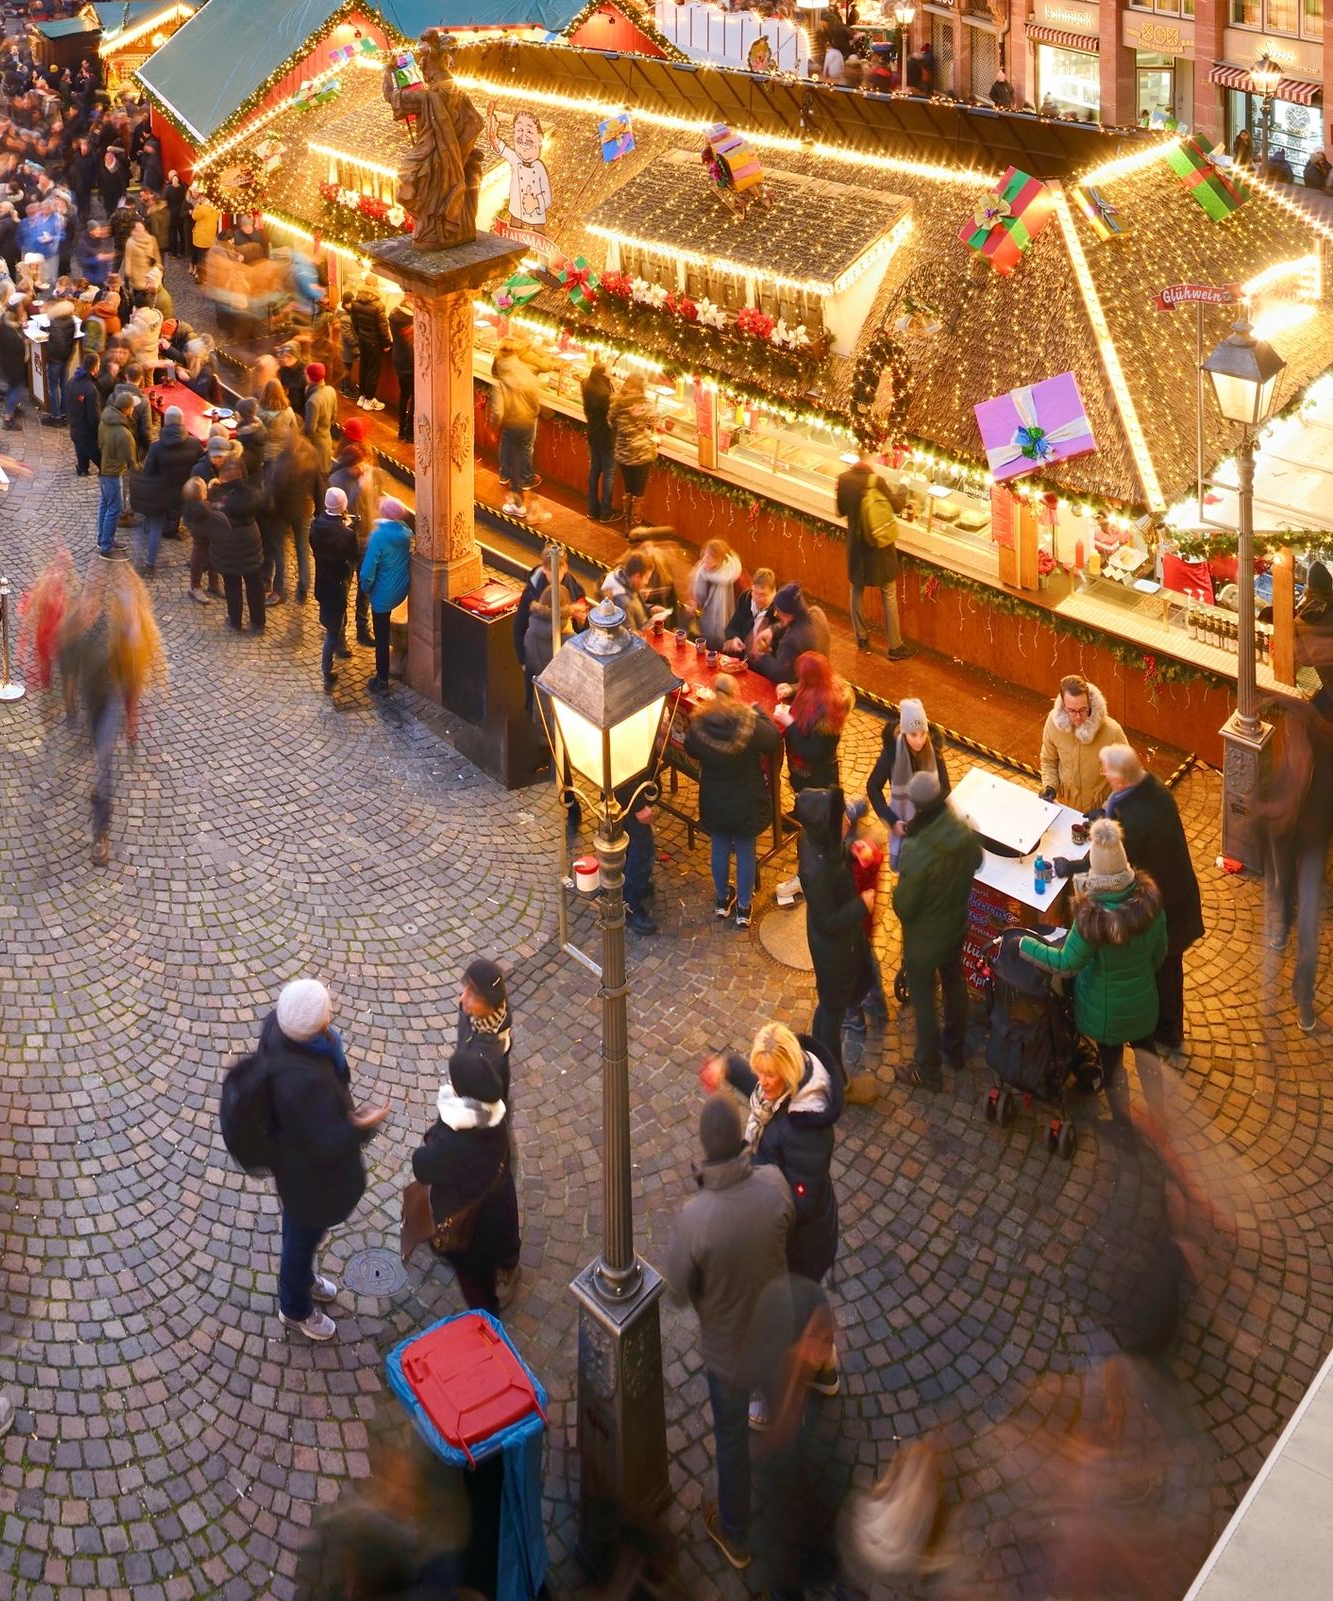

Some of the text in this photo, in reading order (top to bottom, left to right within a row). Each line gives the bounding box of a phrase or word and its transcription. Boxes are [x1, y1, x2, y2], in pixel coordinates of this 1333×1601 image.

[1137, 38, 1151, 49] ZUM
[501, 228, 558, 257] HAUSMANN
[1162, 286, 1222, 303] Glühwein
